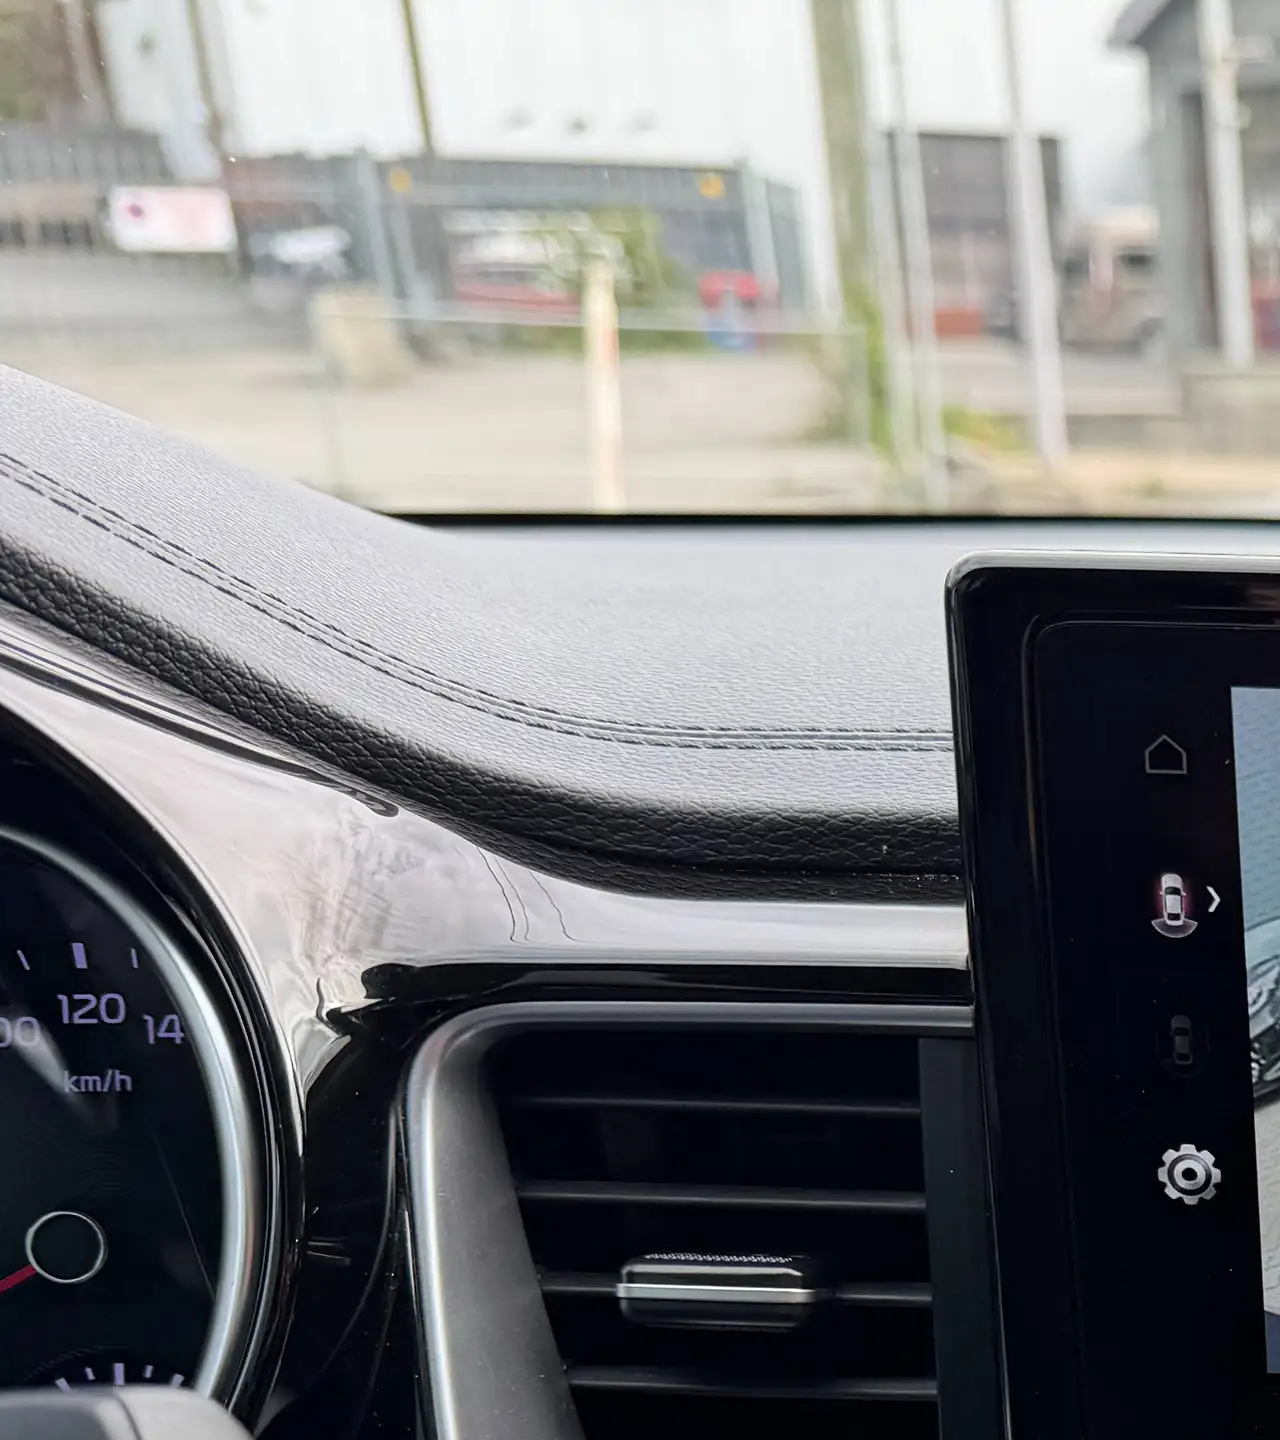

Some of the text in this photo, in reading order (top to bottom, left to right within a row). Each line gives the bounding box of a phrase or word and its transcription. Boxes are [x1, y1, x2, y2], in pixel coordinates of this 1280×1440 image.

[56, 993, 126, 1025] 120
[142, 1013, 186, 1045] 14
[62, 1068, 133, 1094] km/h
